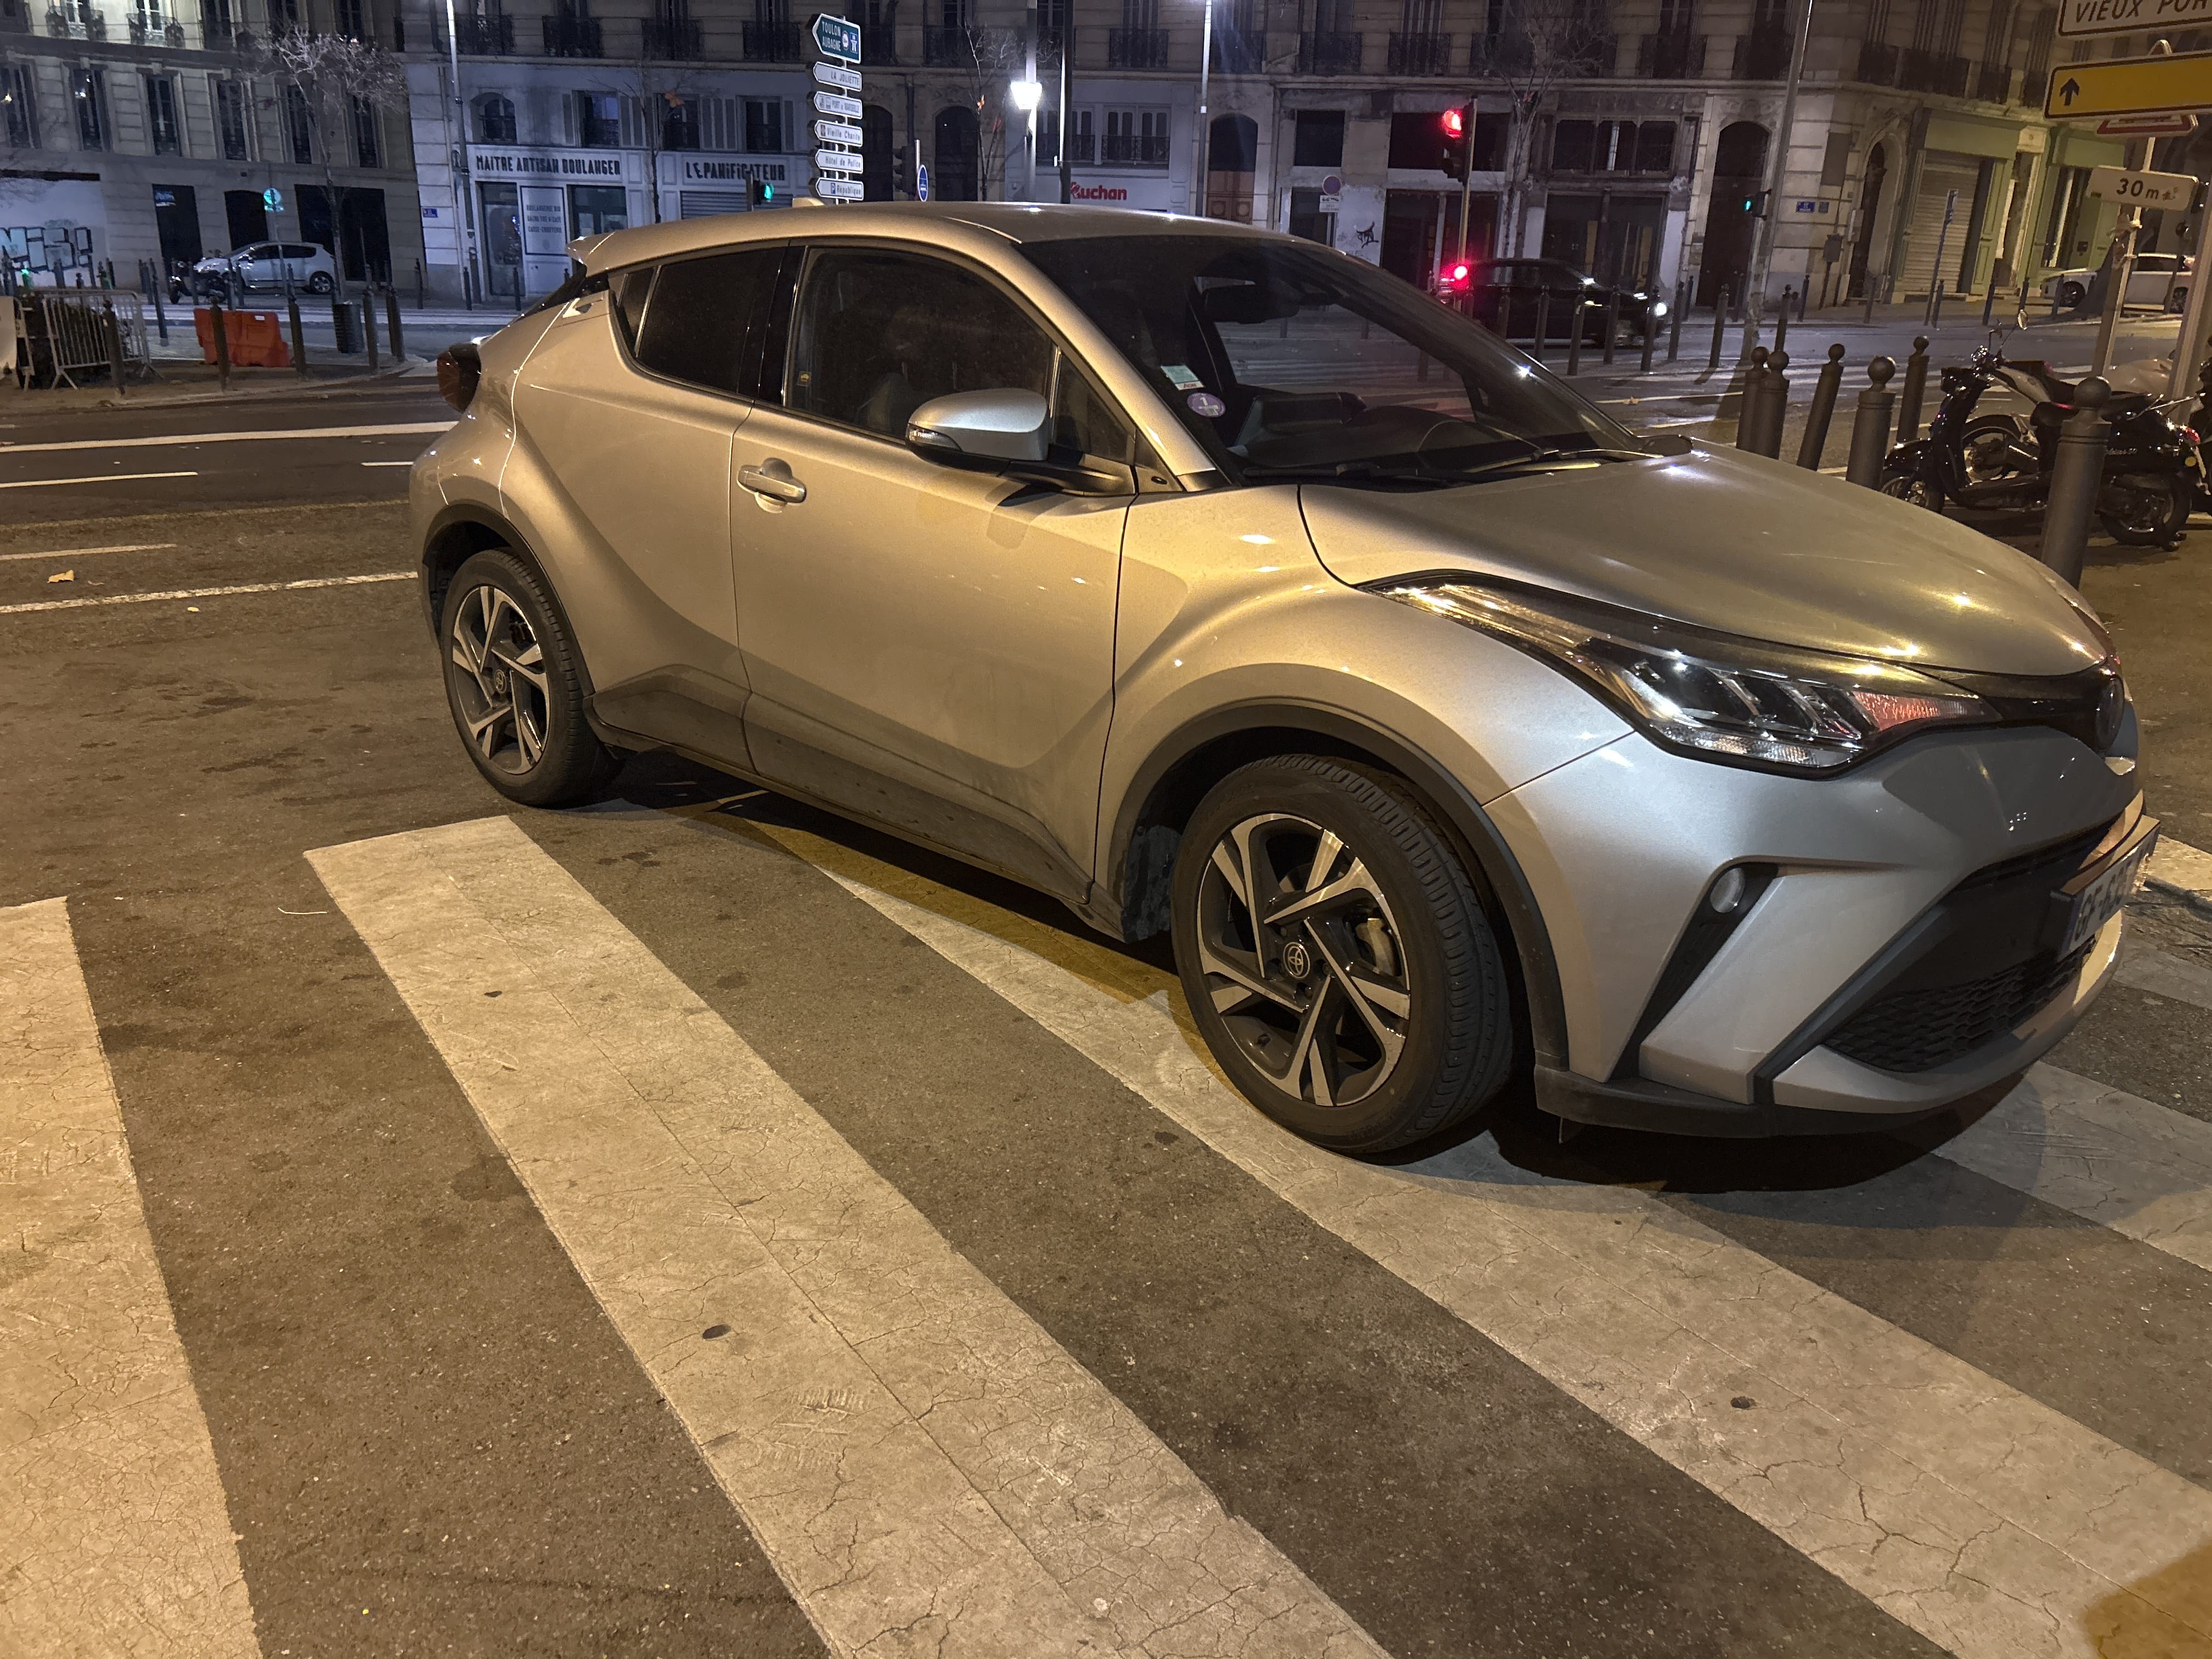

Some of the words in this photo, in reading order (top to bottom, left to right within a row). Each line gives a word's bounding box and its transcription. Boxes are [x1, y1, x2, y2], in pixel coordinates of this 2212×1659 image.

[2075, 0, 2139, 22] VIEUX
[822, 21, 841, 37] TOULON
[822, 36, 841, 52] AUBAGNE
[831, 71, 837, 80] LA
[840, 74, 859, 86] JOLIETTE
[827, 127, 842, 138] Vieille
[562, 159, 620, 175] BOULANGER
[826, 156, 838, 165] Hôtel
[848, 158, 861, 168] Police
[837, 185, 861, 196] République
[1070, 181, 1127, 200] Auchan
[1200, 397, 1208, 405] 1
